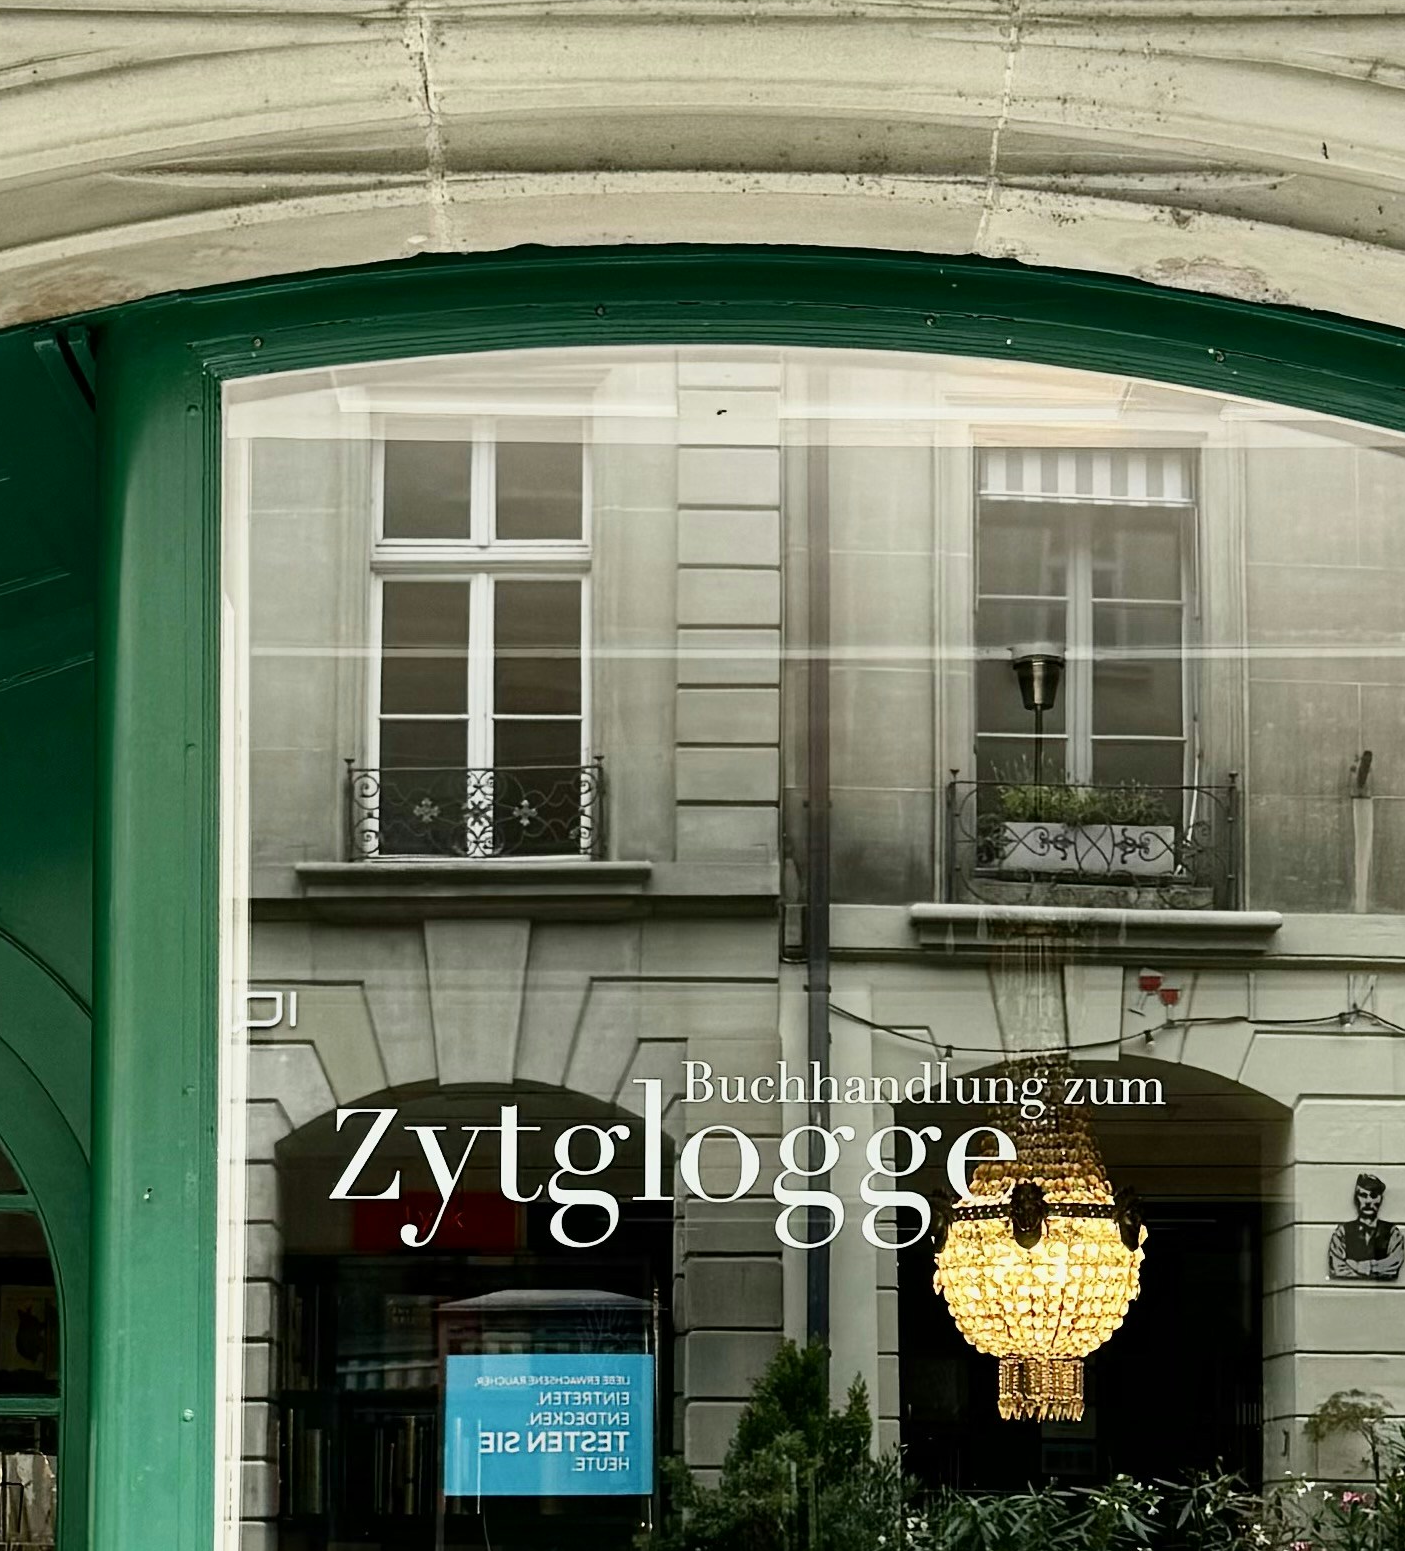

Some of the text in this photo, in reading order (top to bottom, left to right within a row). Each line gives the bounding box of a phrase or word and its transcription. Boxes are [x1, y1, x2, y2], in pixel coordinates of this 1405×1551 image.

[680, 1060, 1167, 1119] Buchhandlung zum
[328, 1076, 1019, 1249] Zytglogge
